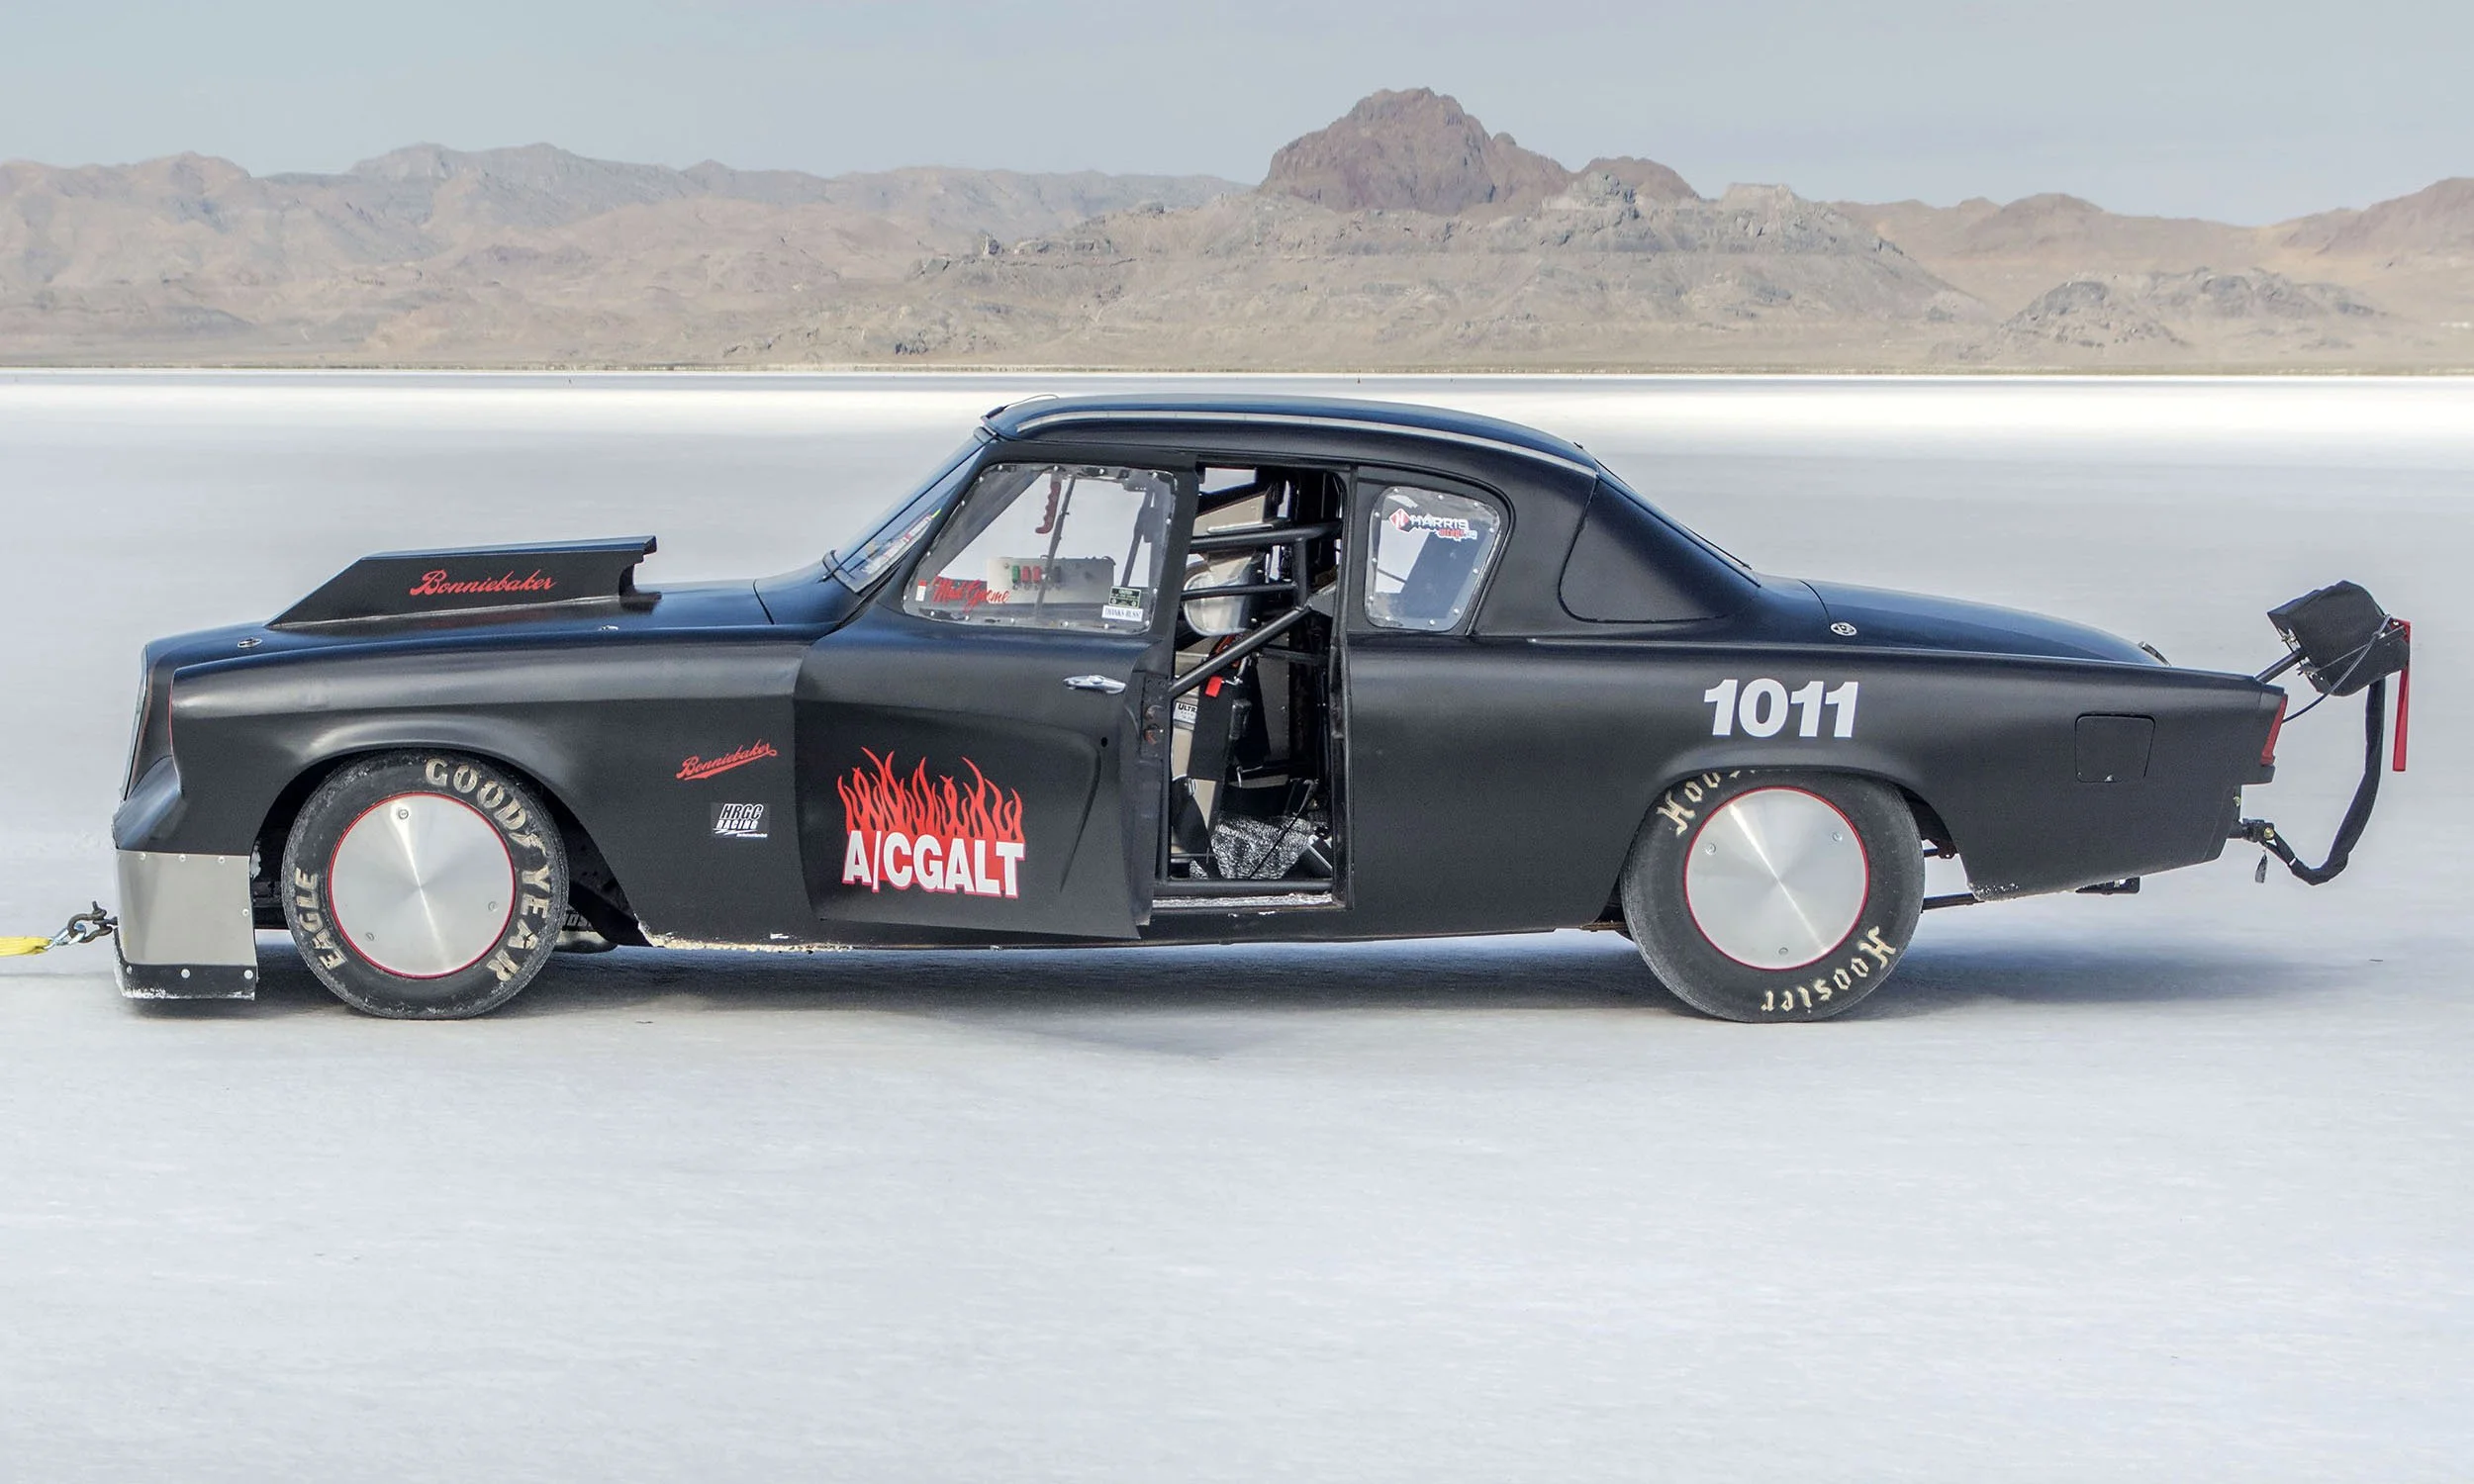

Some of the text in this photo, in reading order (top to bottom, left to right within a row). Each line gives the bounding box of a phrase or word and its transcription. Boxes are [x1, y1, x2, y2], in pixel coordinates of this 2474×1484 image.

[1410, 513, 1469, 530] HARRIS
[409, 569, 559, 596] Bonniebaker
[1178, 703, 1196, 712] ULTR
[1703, 678, 1859, 738] 1011
[676, 738, 777, 780] Bonniebaker
[714, 819, 759, 830] RACING
[719, 803, 764, 820] HRGC
[841, 830, 1025, 898] A/CGALT
[295, 867, 347, 971] EAGLE
[1760, 926, 1897, 1014] Hoosier
